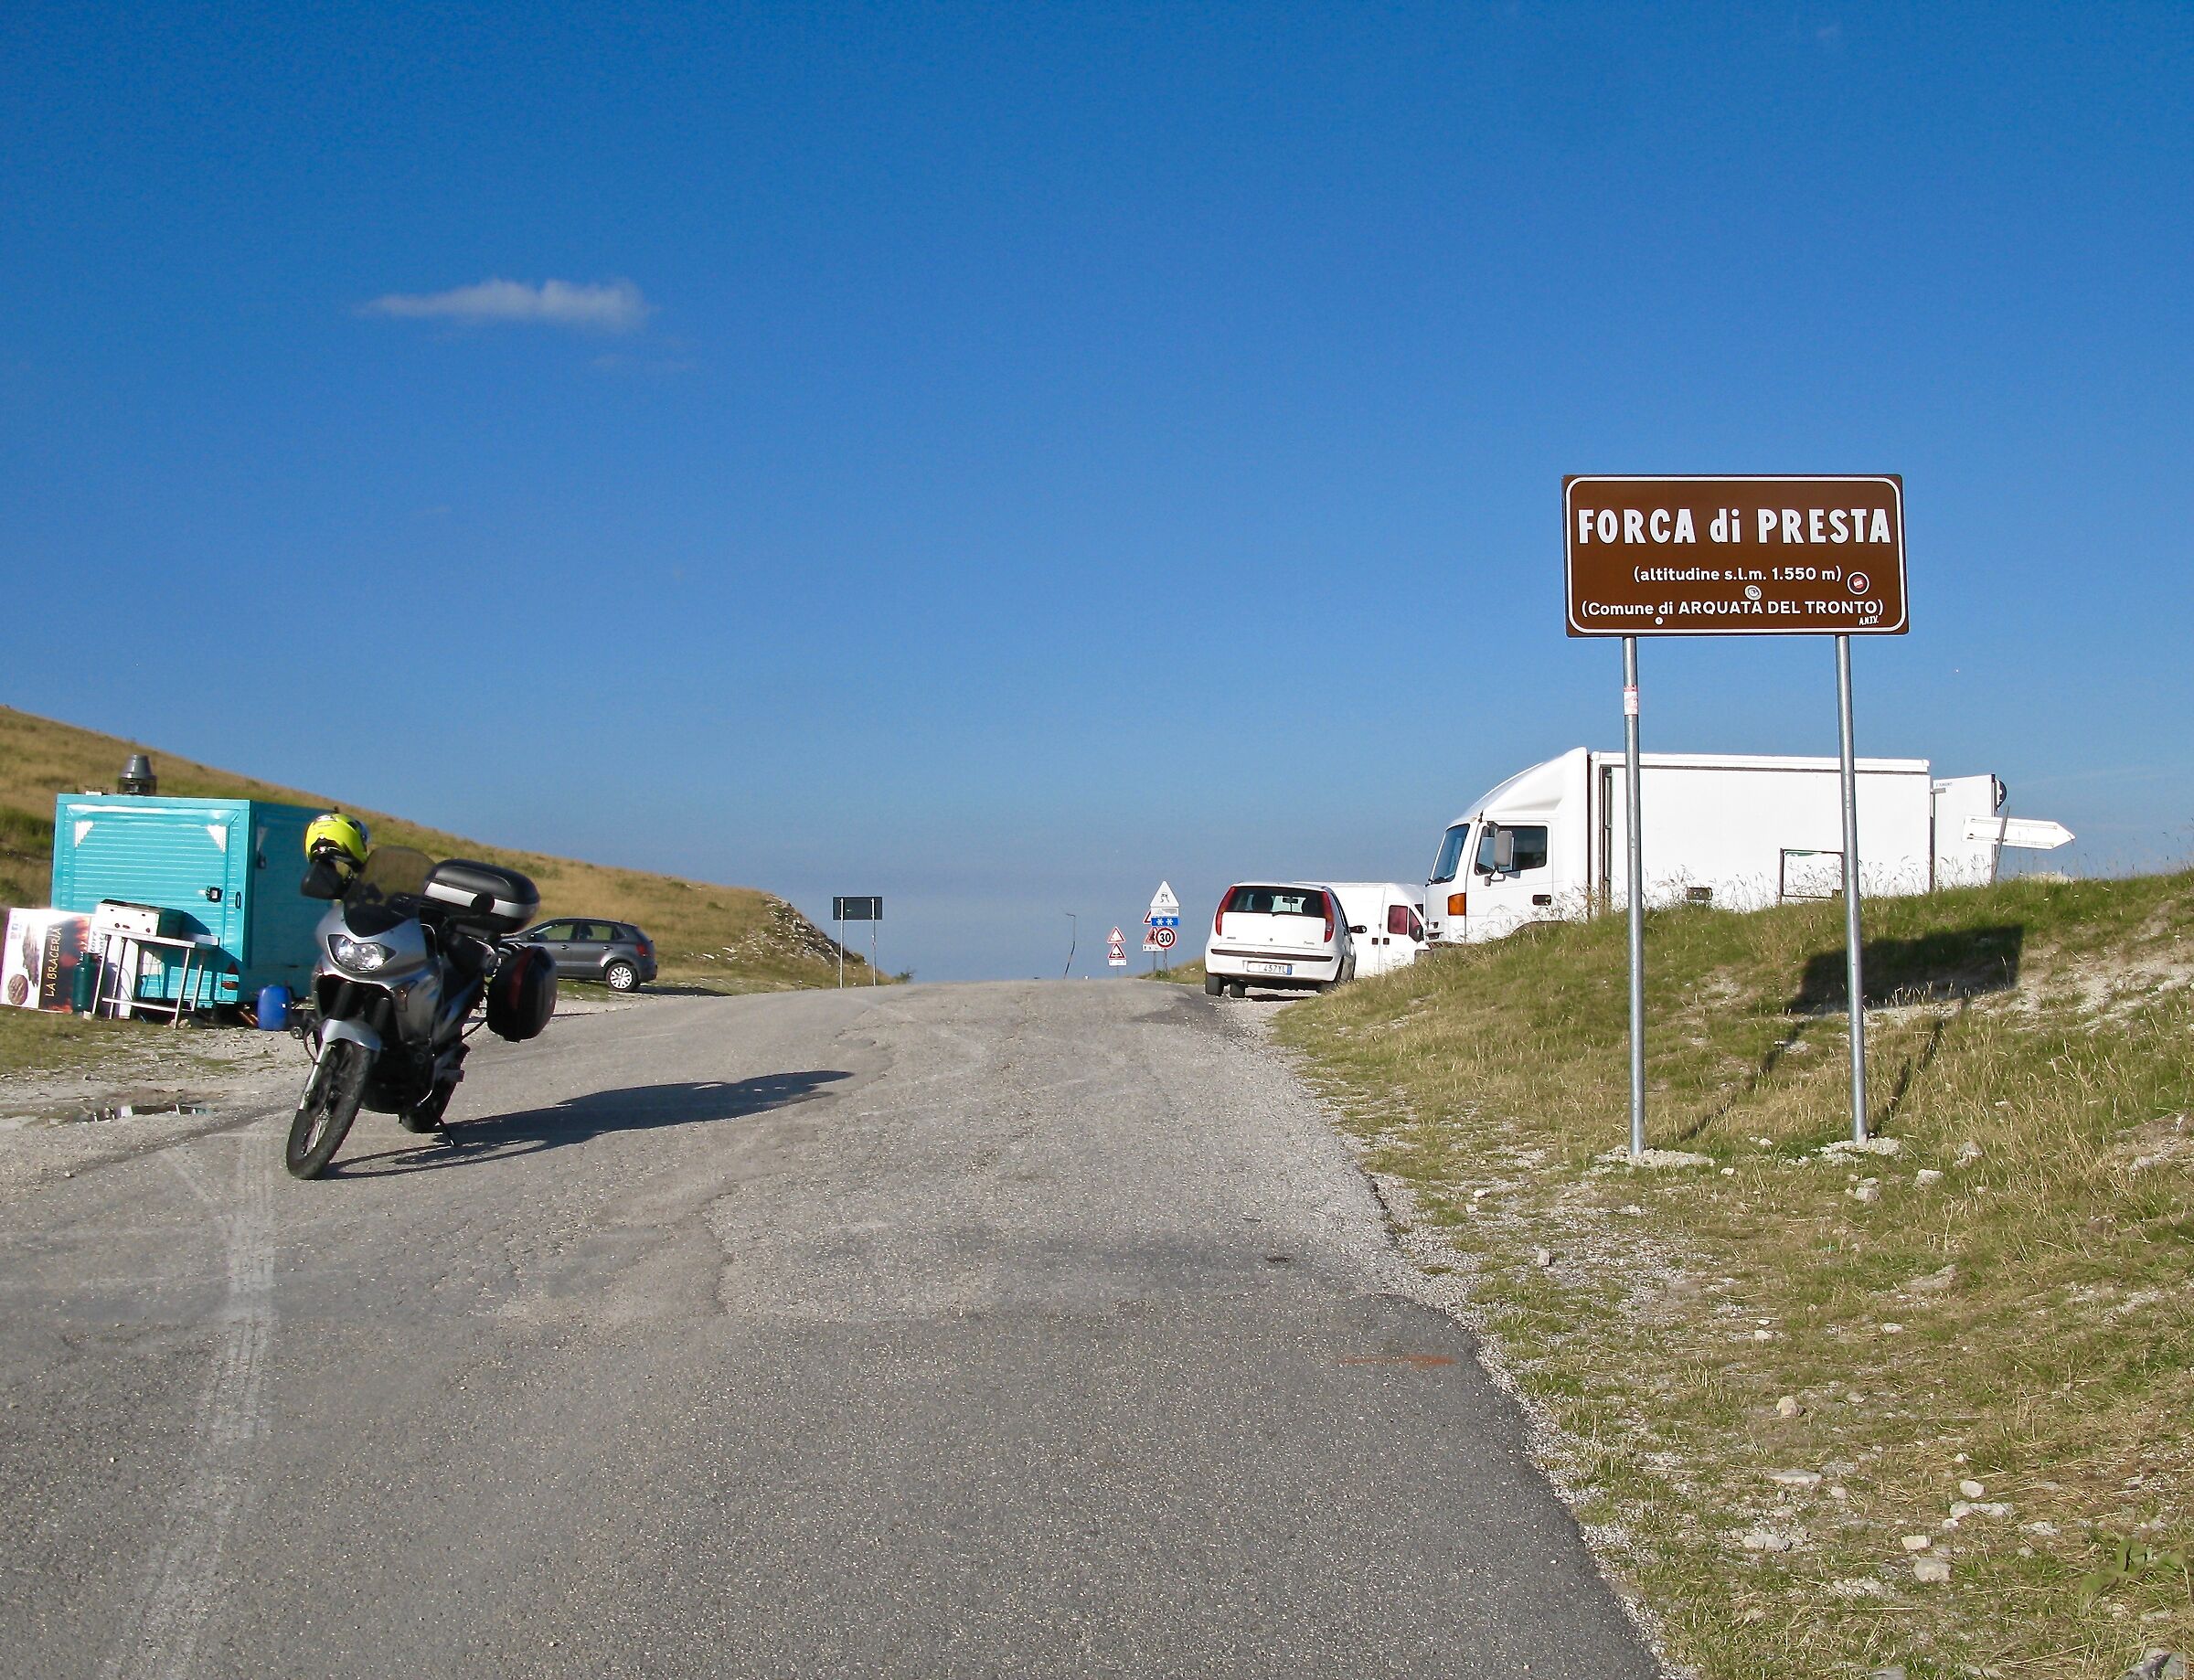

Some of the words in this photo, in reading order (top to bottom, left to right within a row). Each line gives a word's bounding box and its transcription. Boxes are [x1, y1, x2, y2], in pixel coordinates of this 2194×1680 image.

[1578, 508, 1697, 544] FORCA
[1709, 507, 1741, 543] di
[1757, 508, 1891, 544] PRESTA
[1634, 565, 1720, 583] (altitudine
[1724, 567, 1767, 581] s.l.m.
[1772, 567, 1816, 581] 1.550
[1821, 565, 1842, 583] m)
[1582, 600, 1655, 618] (Comune
[1658, 601, 1674, 615] di
[1677, 601, 1763, 615] ARQUATA
[1767, 601, 1801, 615] DEL
[1804, 599, 1884, 616] TRONTO)
[1159, 932, 1171, 943] 30
[45, 983, 58, 997] LA
